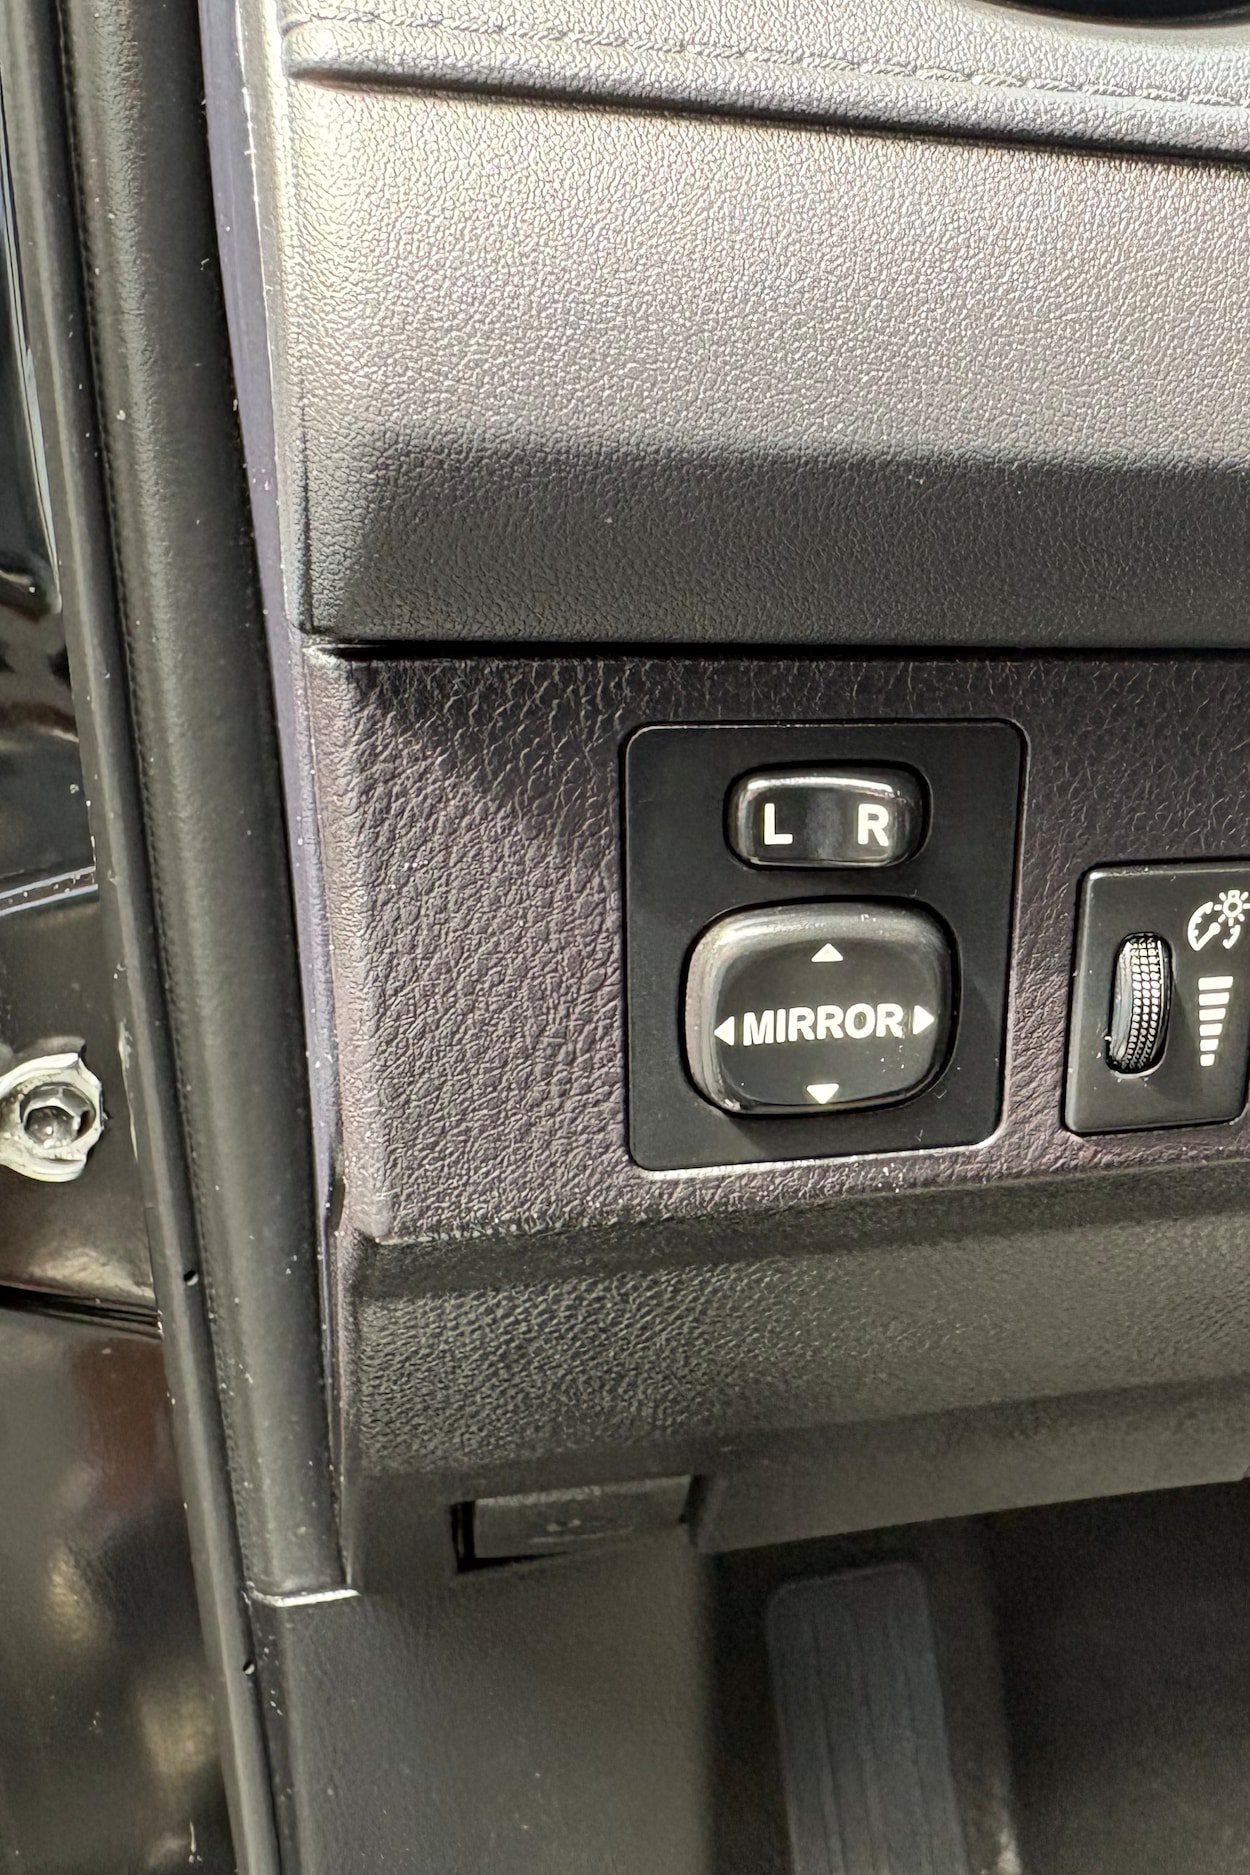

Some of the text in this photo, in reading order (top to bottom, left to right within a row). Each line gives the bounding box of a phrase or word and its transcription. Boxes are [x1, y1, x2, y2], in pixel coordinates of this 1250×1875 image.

[763, 802, 890, 847] L R
[742, 1002, 904, 1046] MIRROR
